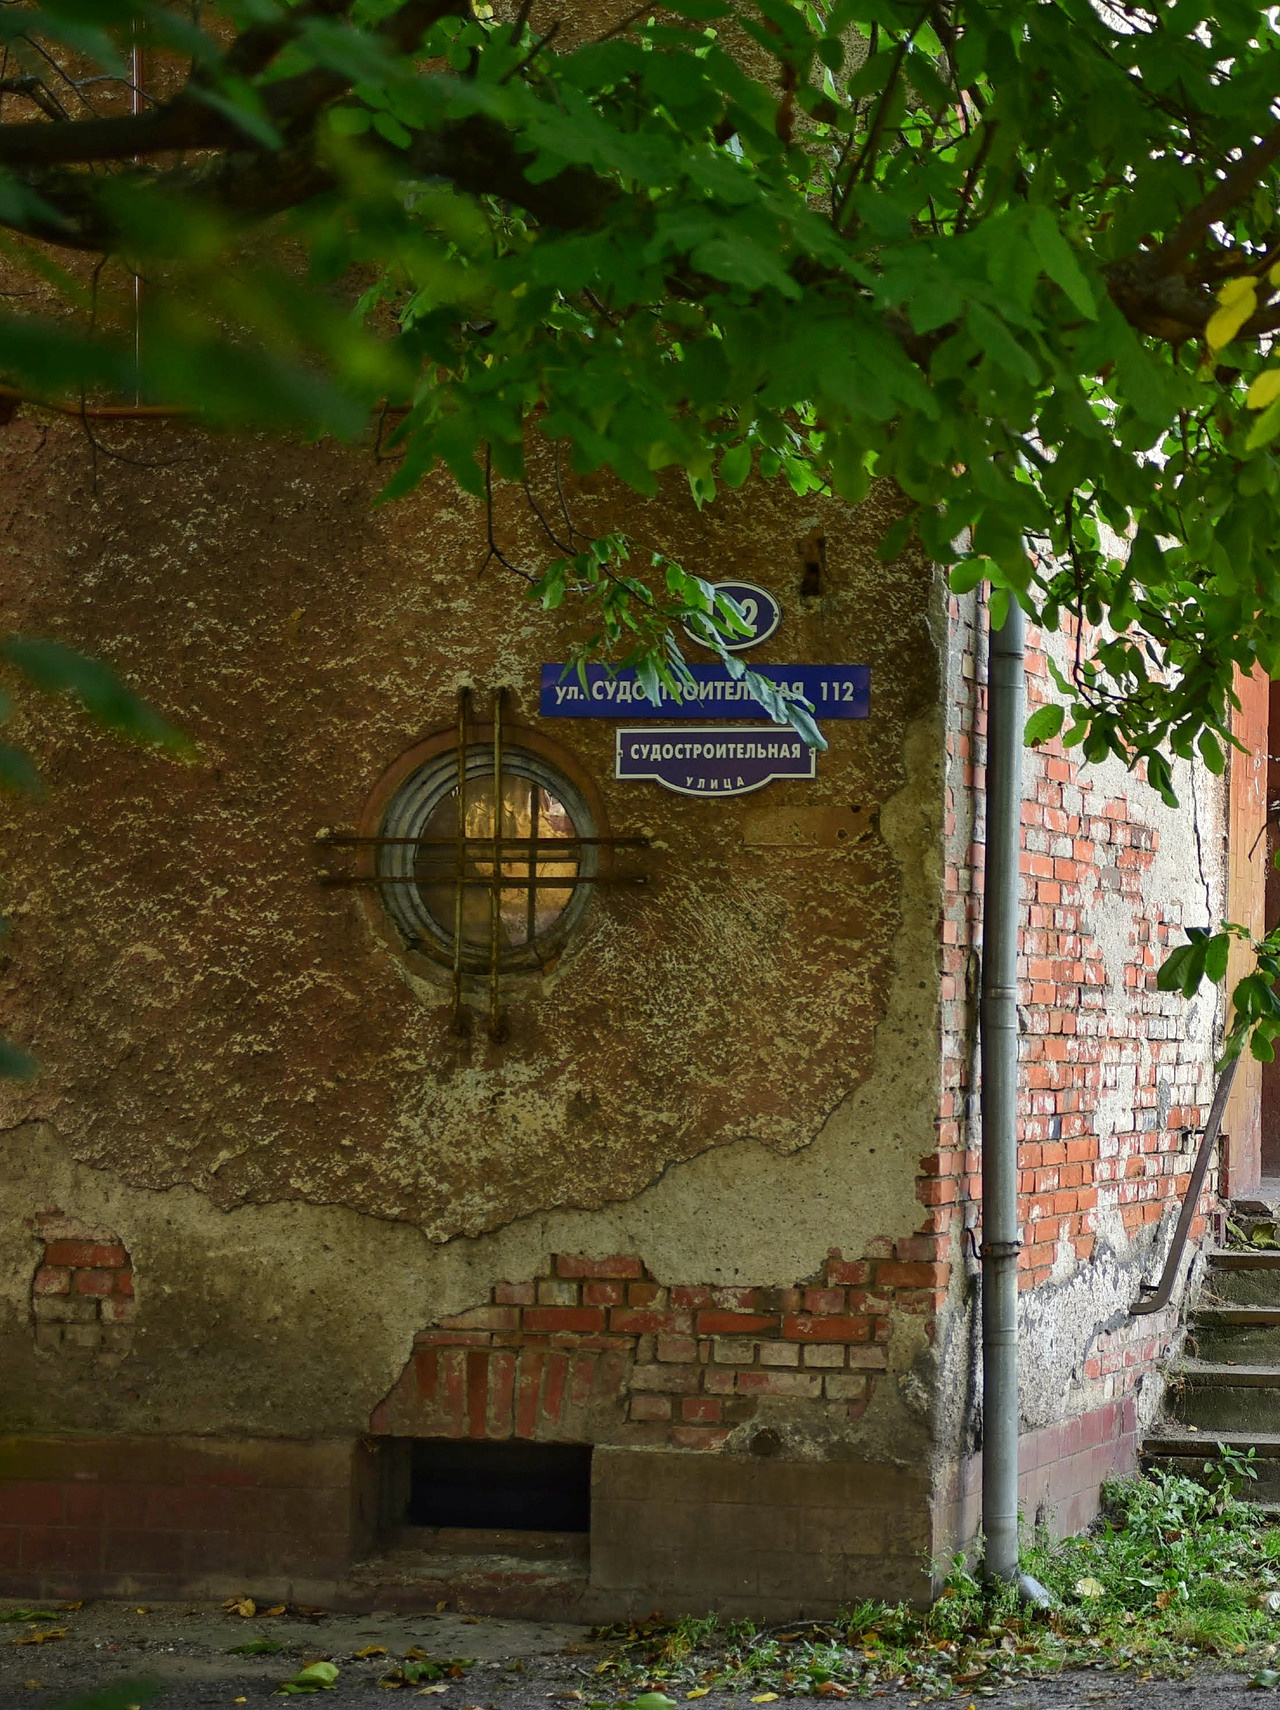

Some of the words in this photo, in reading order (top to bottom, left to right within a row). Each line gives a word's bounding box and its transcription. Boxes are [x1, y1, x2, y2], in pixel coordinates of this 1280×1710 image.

[555, 686, 585, 705] ул.
[821, 681, 854, 701] 112
[630, 743, 801, 762] СУДОСТРОИТЕЛЬНАЯ
[685, 776, 745, 790] УЛИЦА
